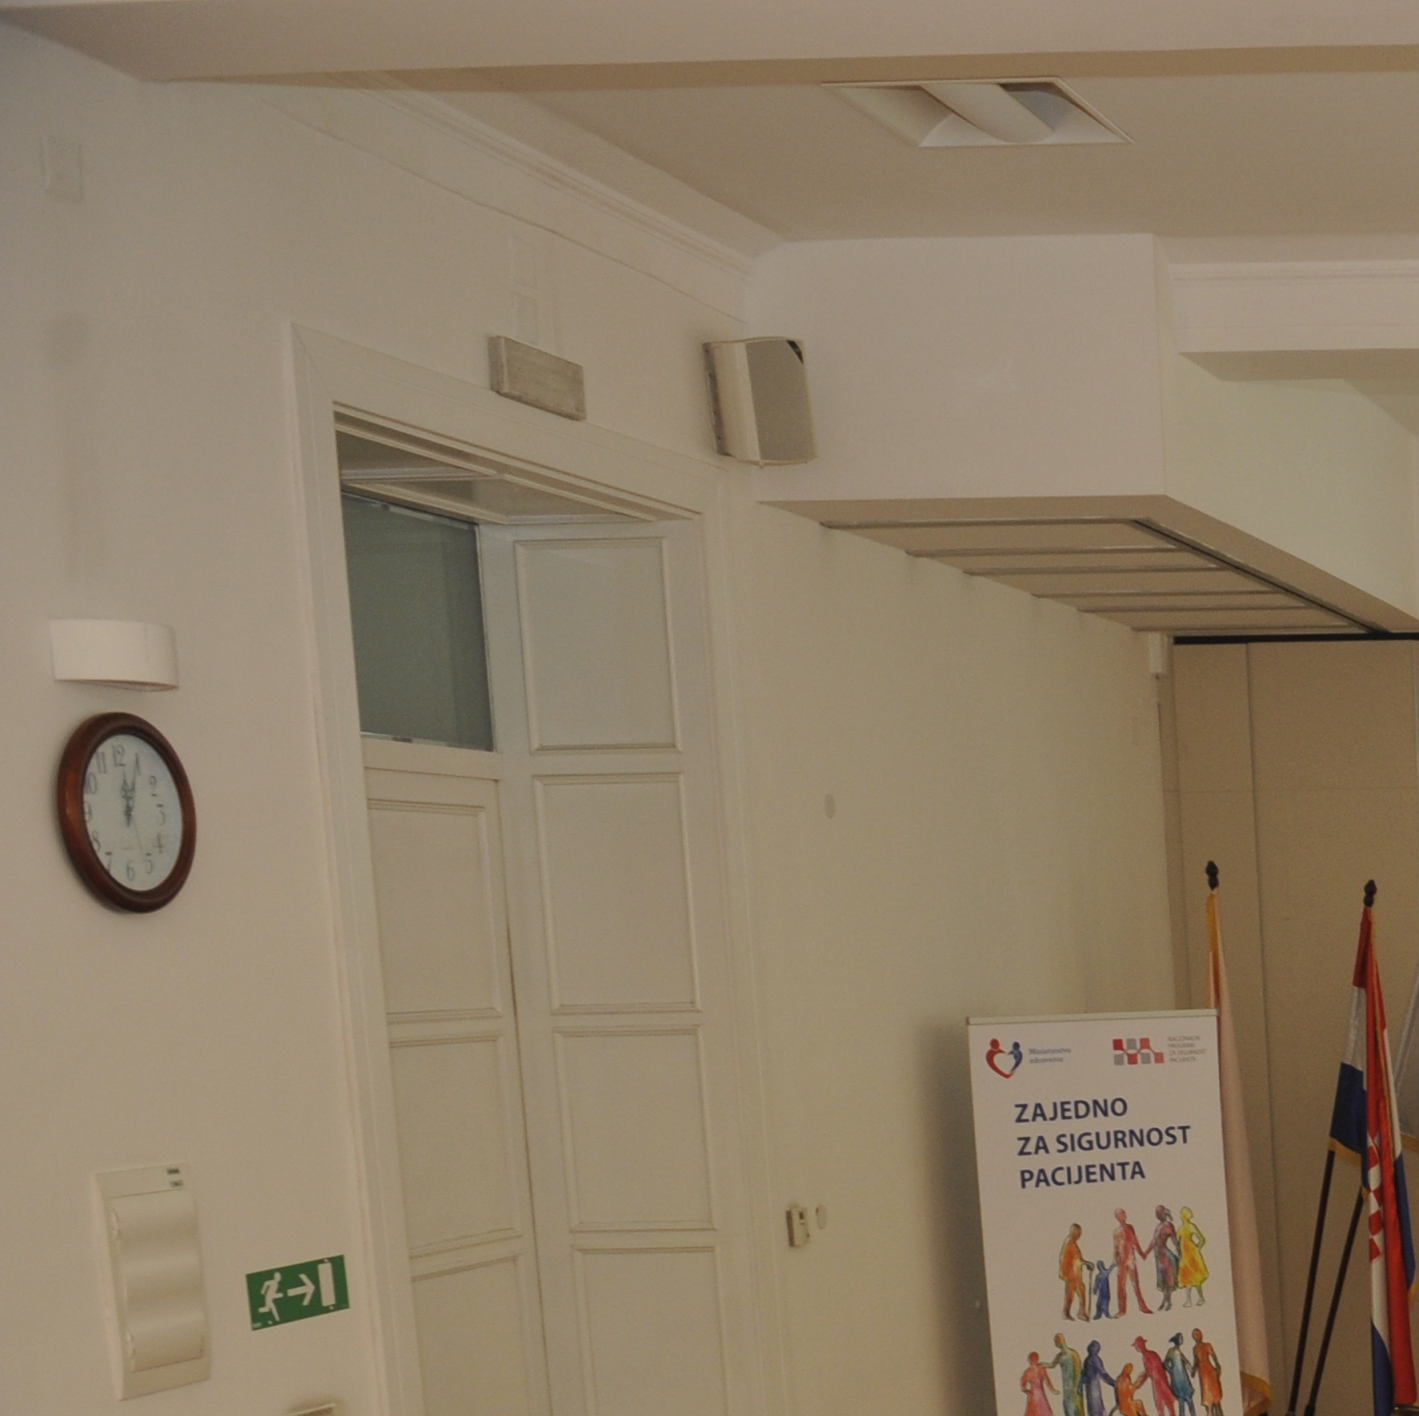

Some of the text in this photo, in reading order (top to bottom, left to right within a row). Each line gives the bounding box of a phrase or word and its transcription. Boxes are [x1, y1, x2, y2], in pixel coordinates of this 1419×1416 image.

[1014, 1097, 1128, 1124] ZAJEDNO
[1017, 1125, 1191, 1157] ZA SIGURNOST
[1020, 1160, 1146, 1189] PACIJENTA
